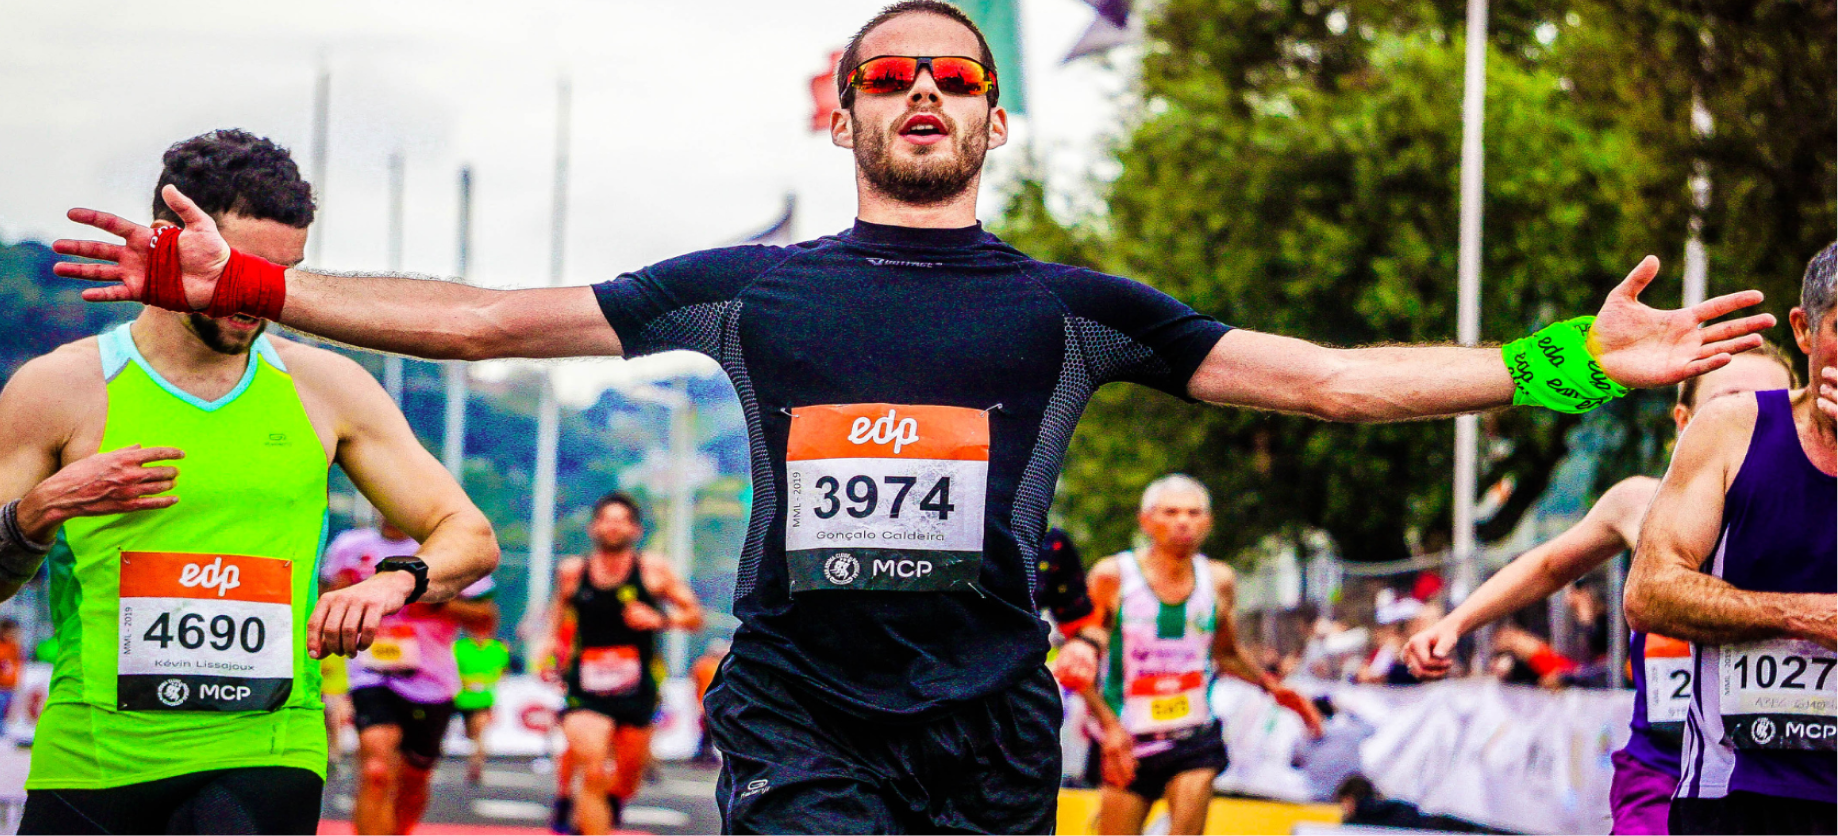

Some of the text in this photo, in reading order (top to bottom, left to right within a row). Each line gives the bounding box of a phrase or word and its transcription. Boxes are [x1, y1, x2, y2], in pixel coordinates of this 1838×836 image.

[847, 409, 920, 454] edp
[792, 471, 802, 495] 2019
[813, 474, 955, 521] 3974
[792, 503, 801, 528] MML
[816, 530, 945, 542] Gonçalo Caldeira
[178, 556, 241, 597] edp
[872, 559, 933, 578] MCP
[124, 606, 133, 626] 2019
[123, 633, 132, 655] MML
[143, 611, 266, 654] 4690
[154, 659, 255, 671] Kévin Lissajoux
[1733, 655, 1837, 691] 1027
[199, 683, 252, 701] MCP
[1785, 721, 1837, 739] MCP
